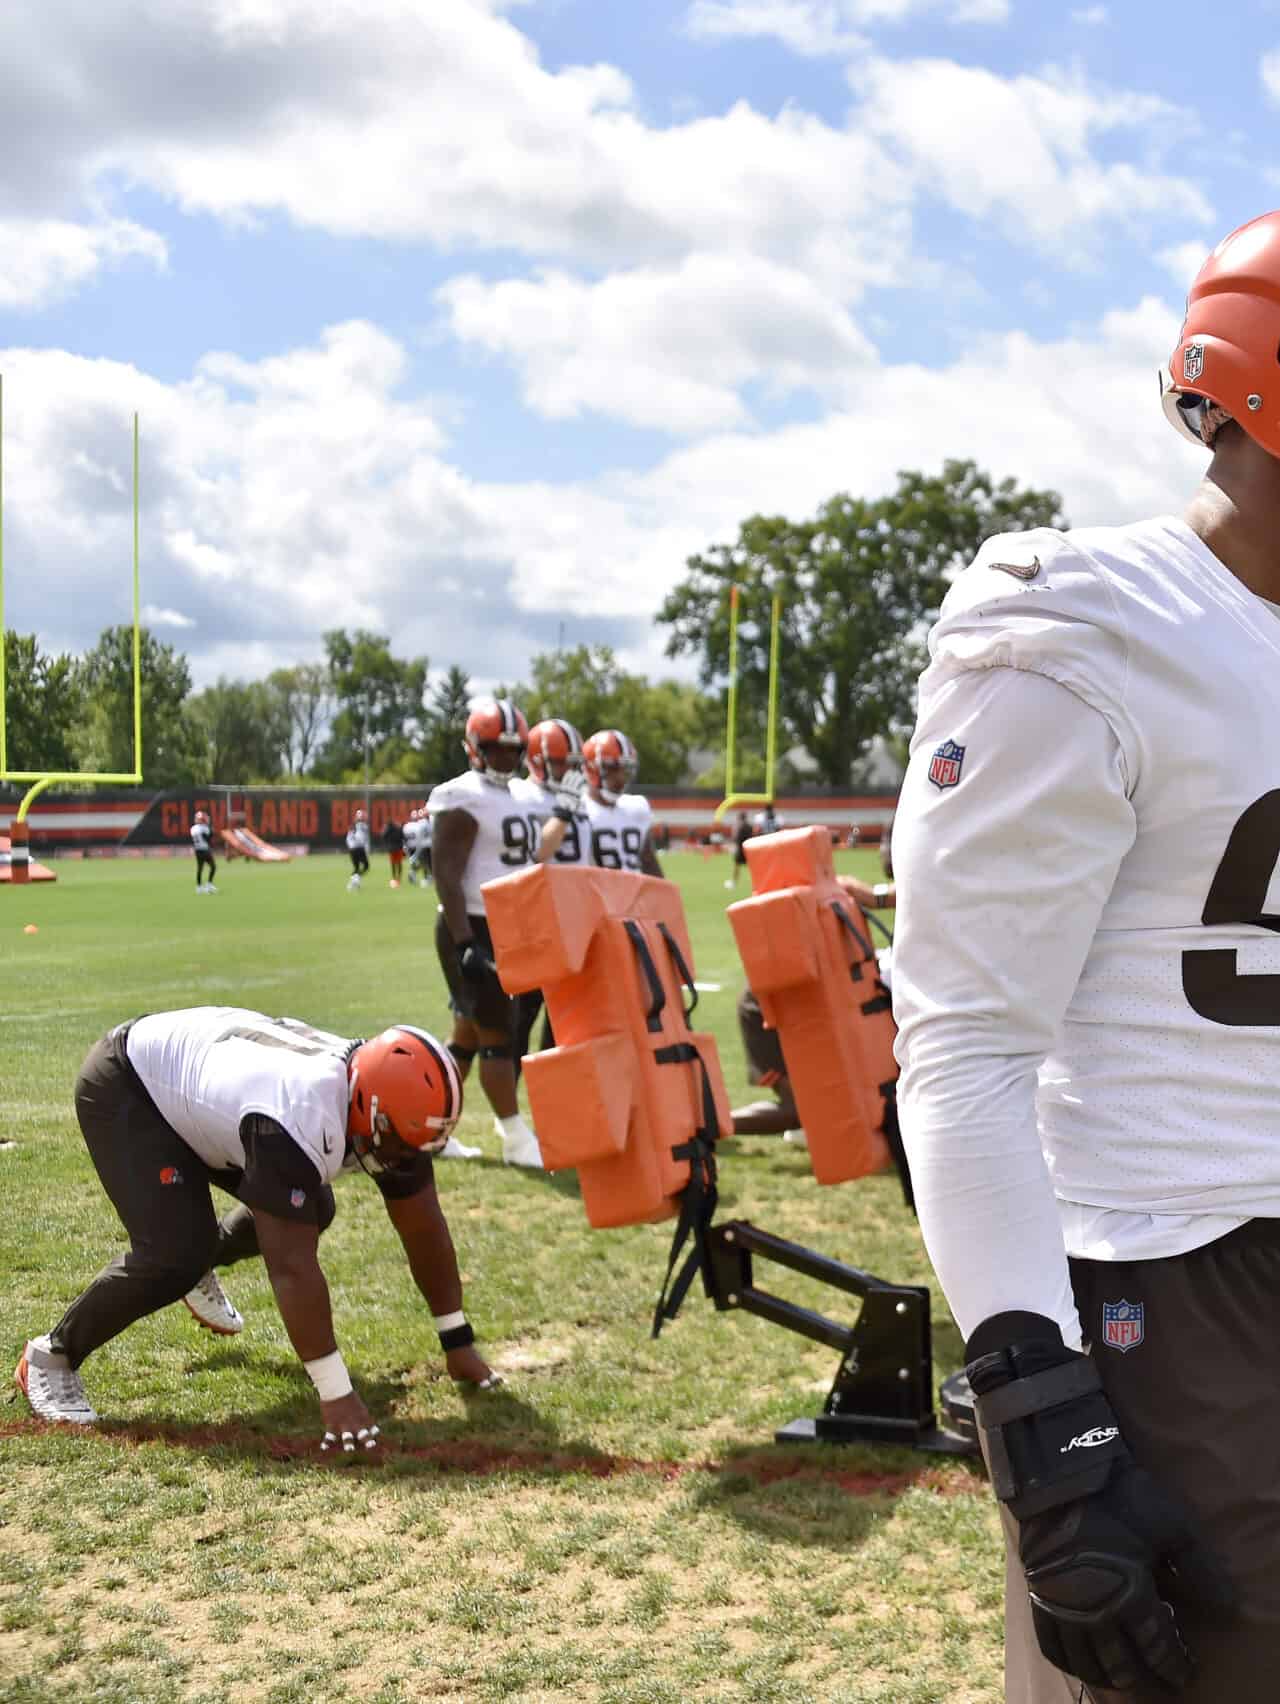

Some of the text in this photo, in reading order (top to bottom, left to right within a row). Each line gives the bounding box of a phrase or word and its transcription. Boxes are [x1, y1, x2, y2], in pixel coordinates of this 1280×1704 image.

[932, 757, 959, 785] NFL
[161, 800, 318, 837] CLVLAND
[592, 828, 642, 871] 69
[1107, 1321, 1140, 1345] NFL
